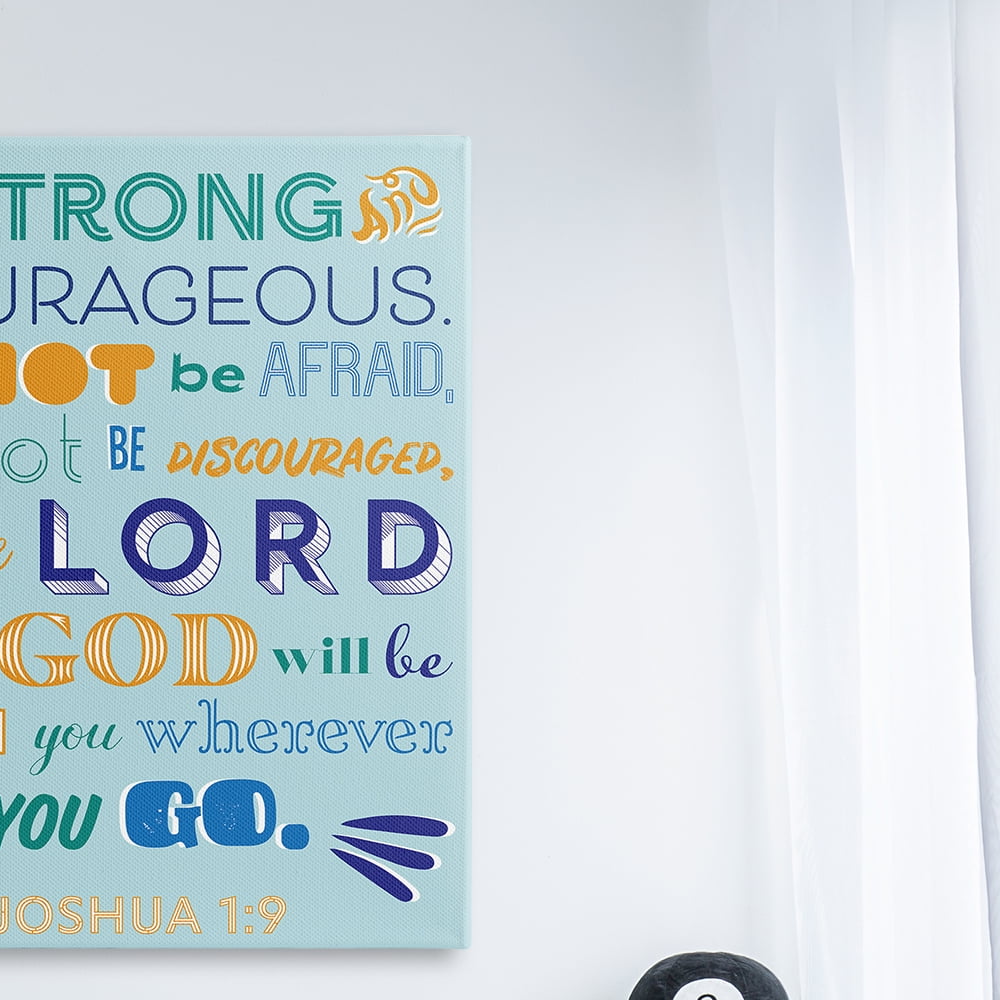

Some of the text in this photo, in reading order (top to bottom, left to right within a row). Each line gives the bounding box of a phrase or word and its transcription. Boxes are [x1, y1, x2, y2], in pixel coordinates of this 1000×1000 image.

[170, 352, 246, 394] be
[258, 340, 454, 404] AFRAID,
[107, 424, 146, 472] BE
[165, 435, 455, 482] DISCOURAGED,
[38, 497, 454, 597] LORD
[272, 636, 369, 675] will
[385, 622, 454, 680] be
[29, 722, 123, 777] you
[135, 697, 454, 755] wherever
[119, 778, 311, 851] GO.
[218, 895, 287, 935] 1:9
